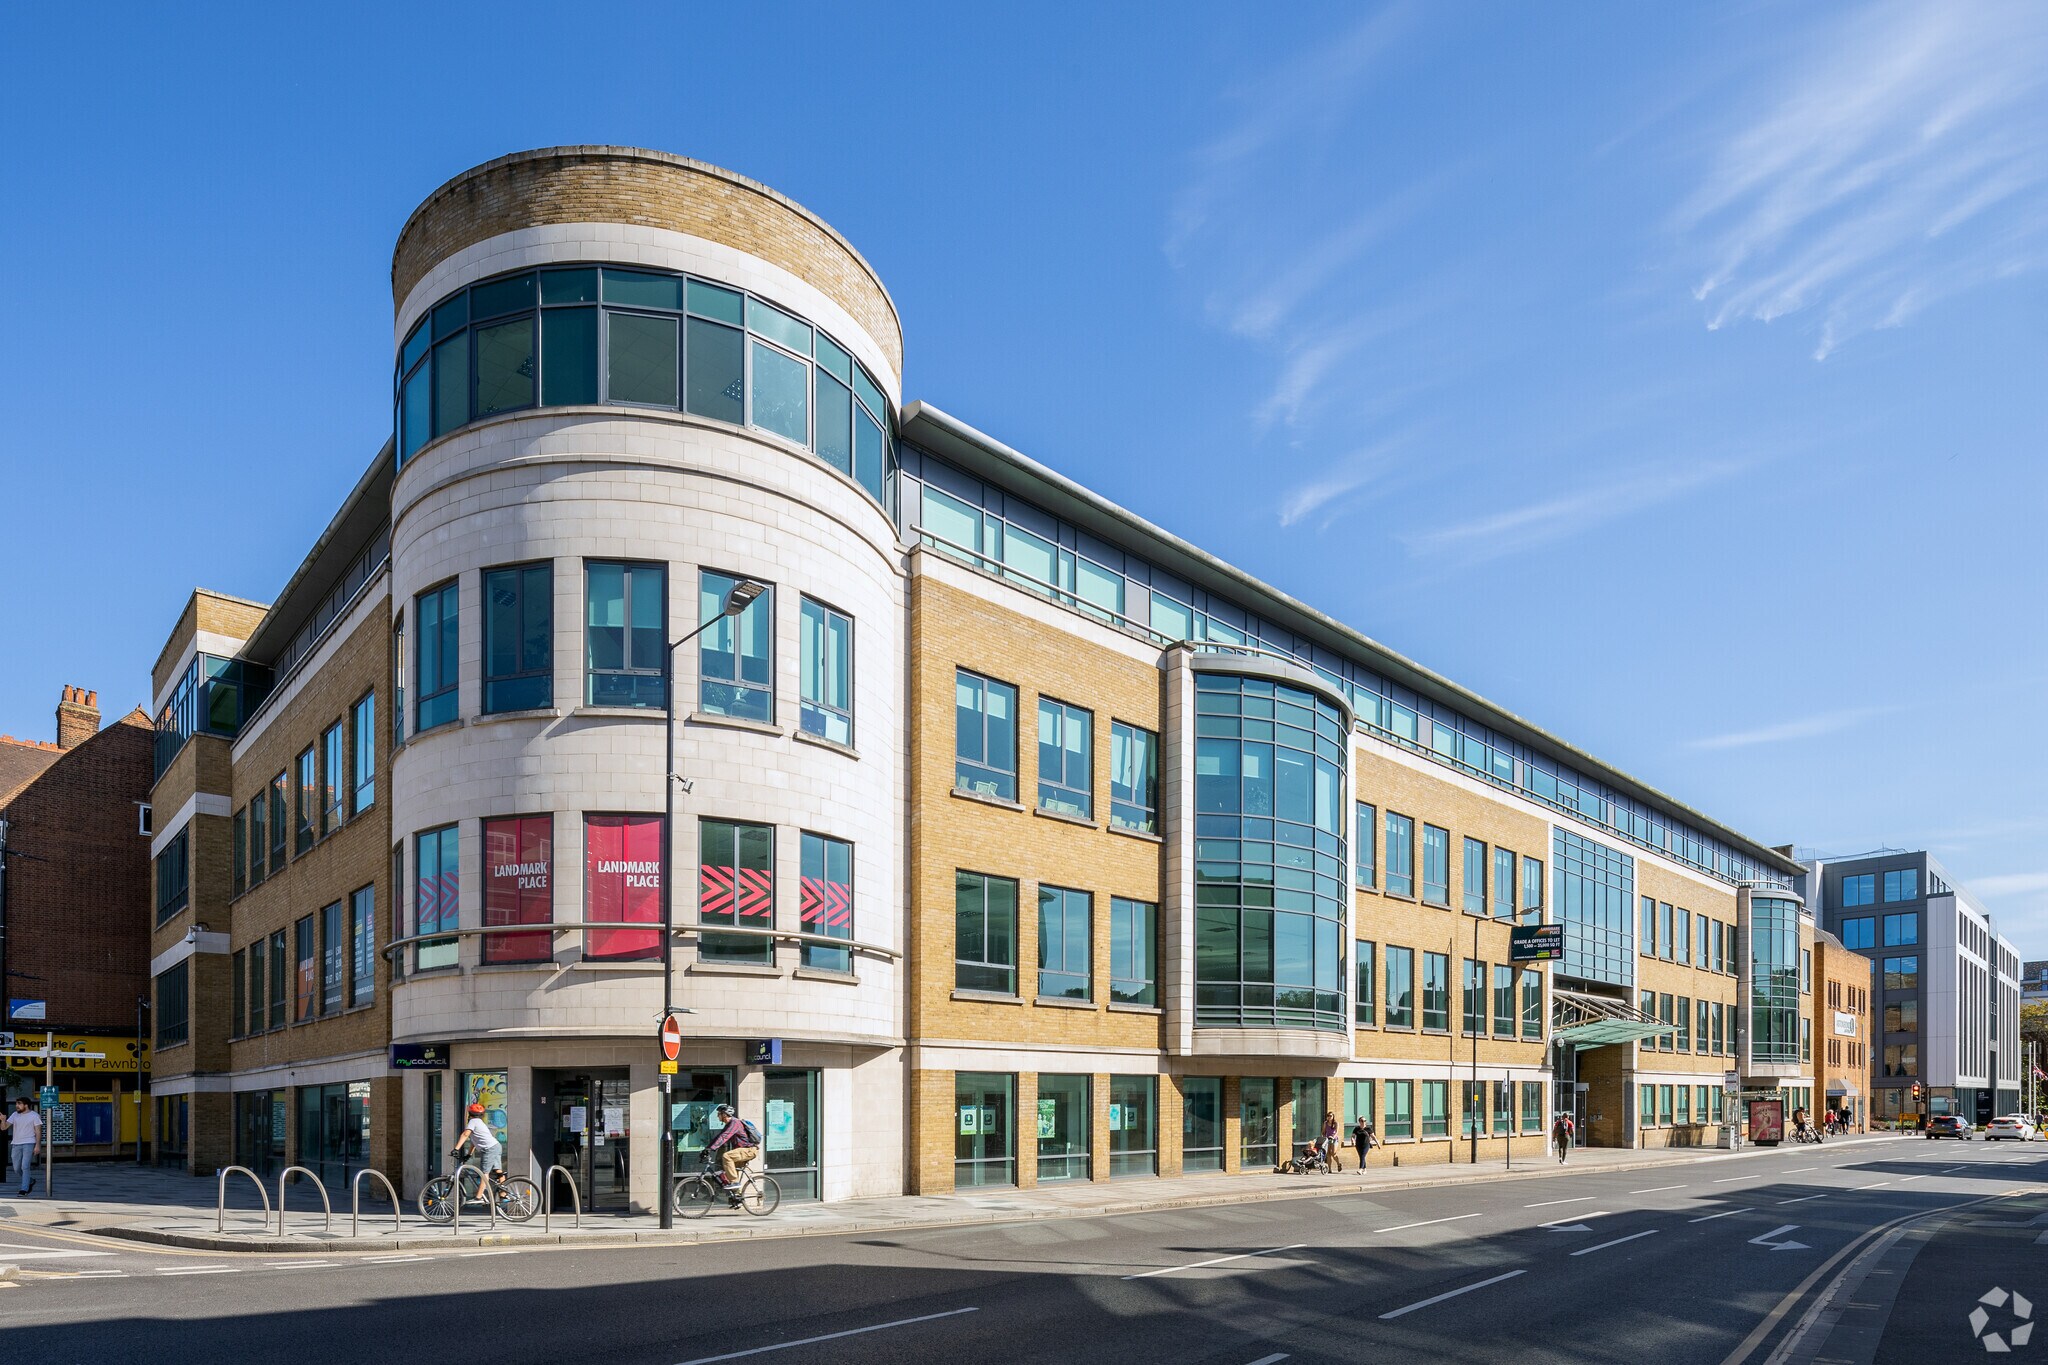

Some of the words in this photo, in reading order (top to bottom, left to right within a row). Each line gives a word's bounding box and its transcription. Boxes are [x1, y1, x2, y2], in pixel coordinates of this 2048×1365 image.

[495, 862, 547, 877] LANDMARK
[598, 861, 659, 873] LANDMARK
[518, 876, 547, 888] PLACE
[626, 875, 659, 888] PLACE
[14, 1040, 68, 1048] Albemrle
[11, 1047, 86, 1068] Bond
[93, 1058, 151, 1069] Pawnbo
